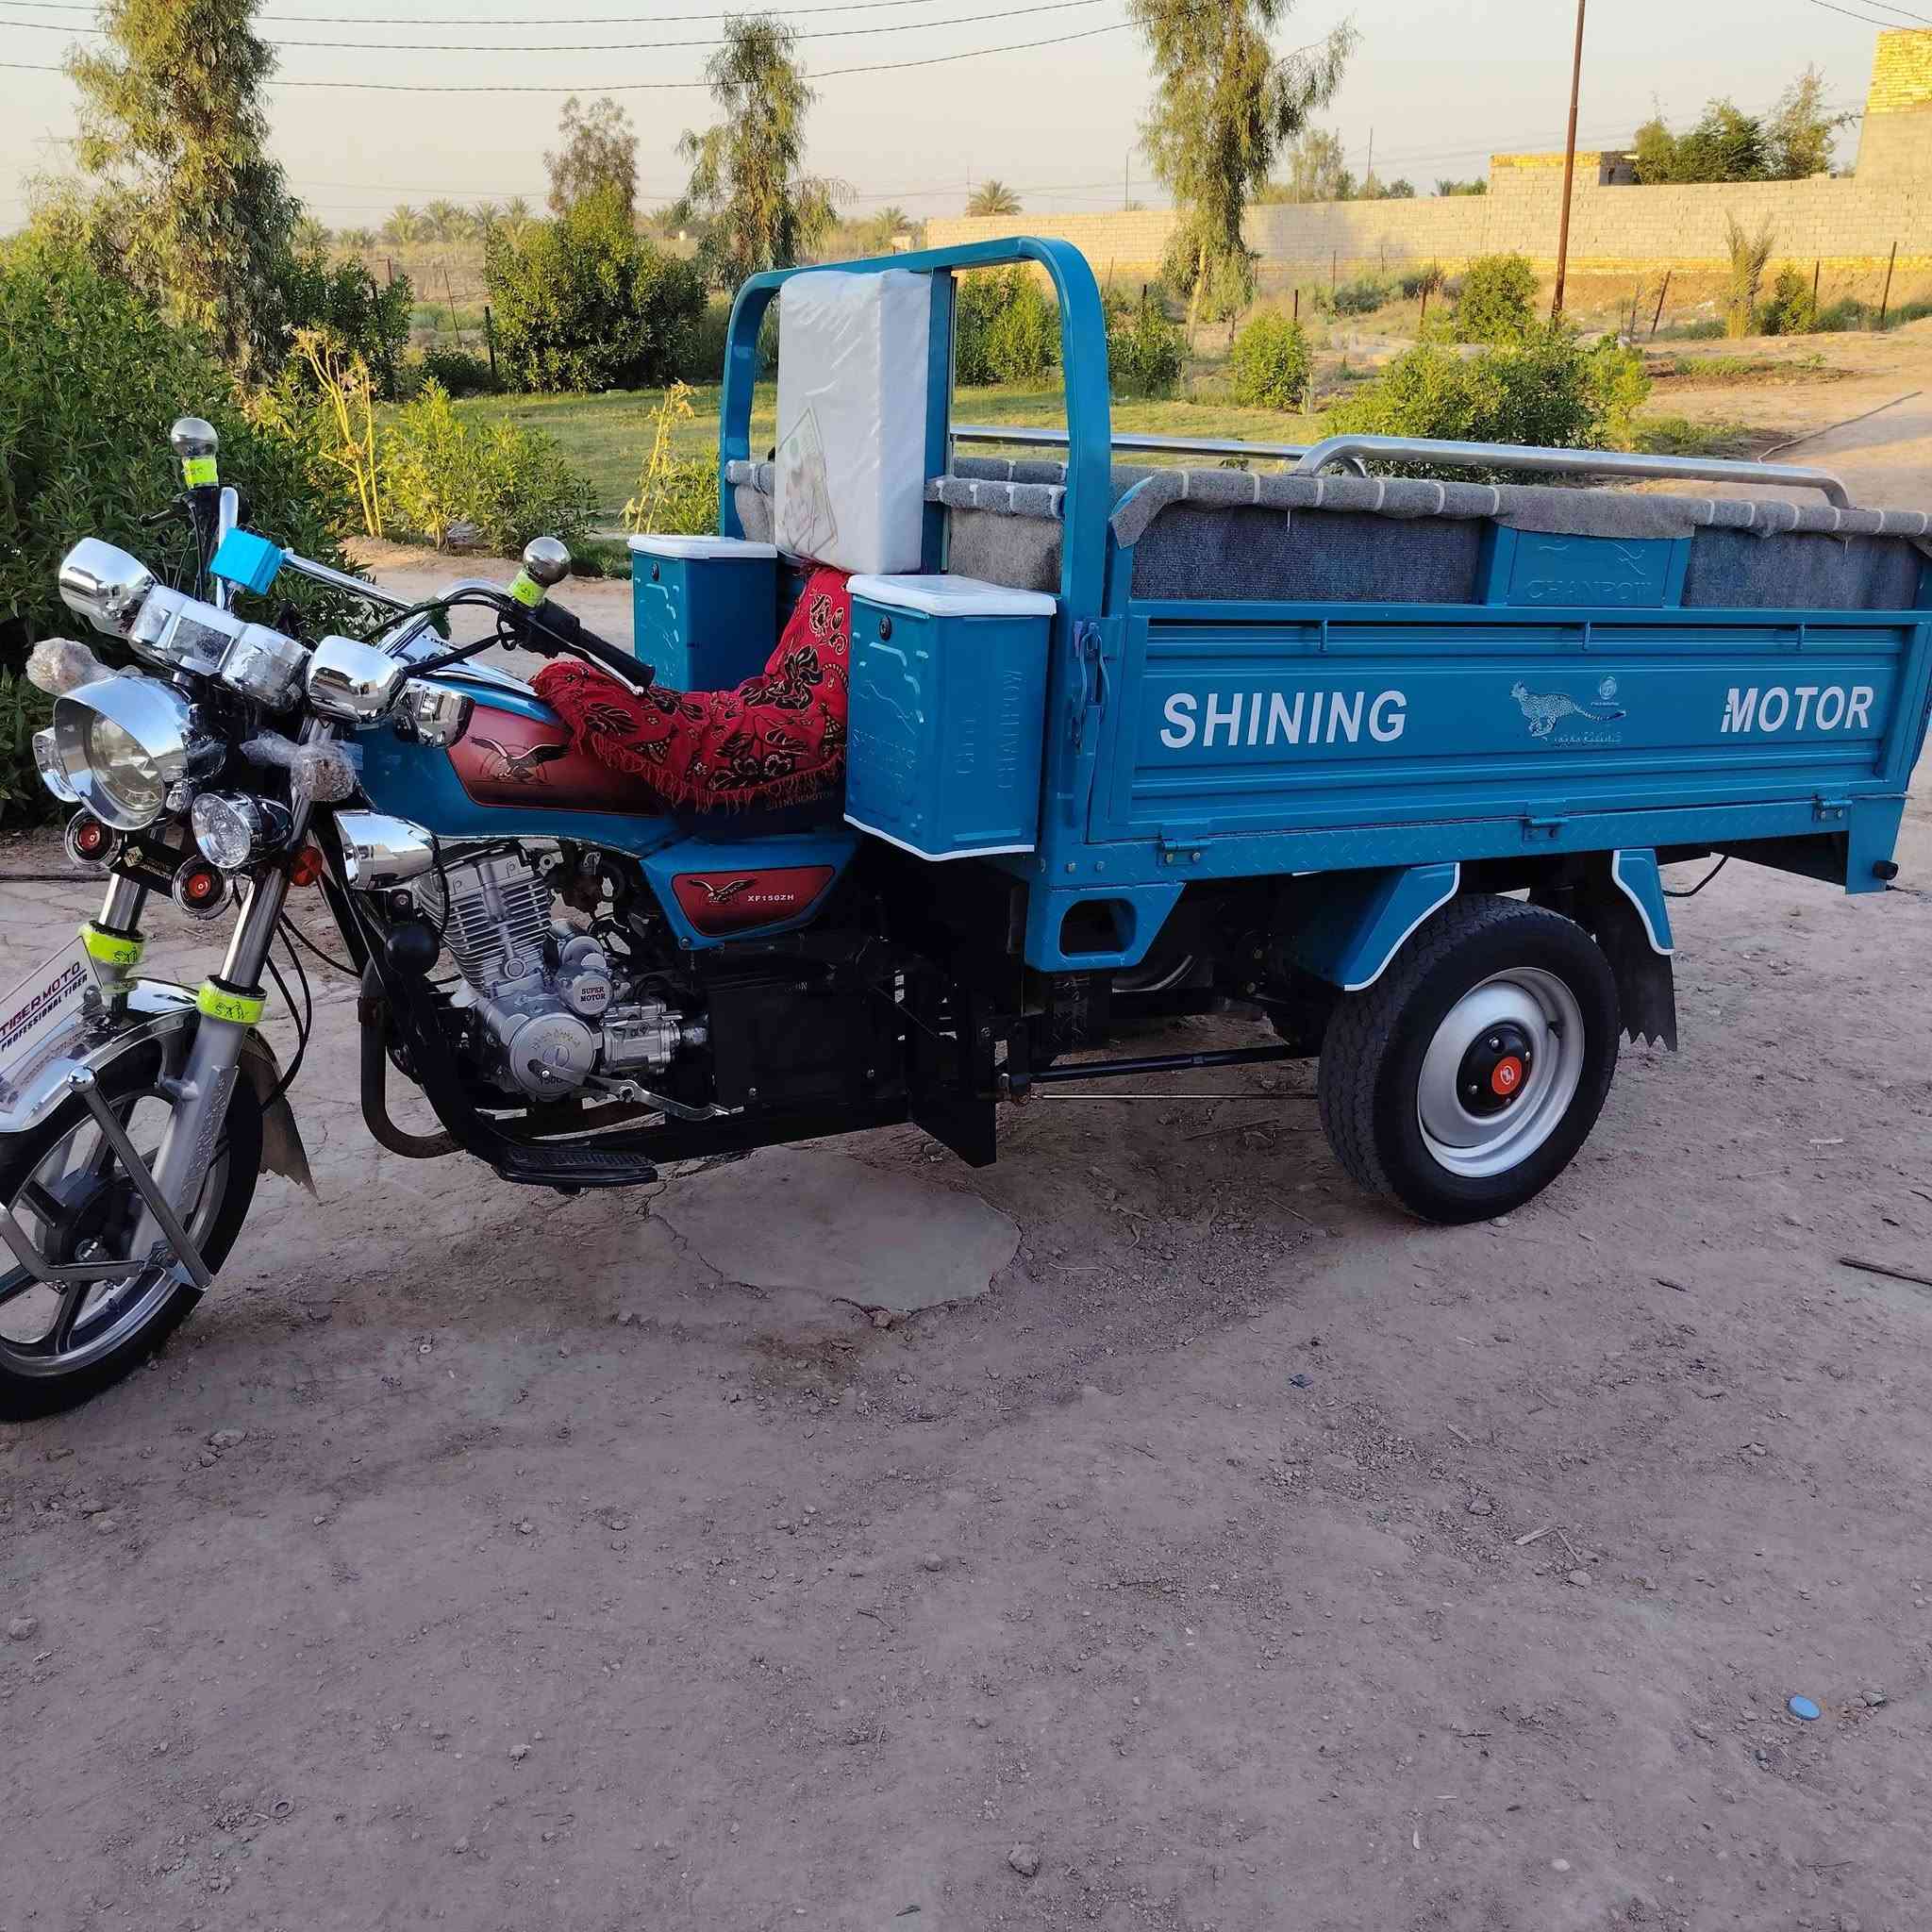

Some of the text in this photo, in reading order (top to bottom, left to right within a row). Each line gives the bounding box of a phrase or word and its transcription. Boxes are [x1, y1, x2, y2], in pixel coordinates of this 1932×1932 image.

[1160, 686, 1874, 748] SHINING MOTOR
[747, 894, 794, 903] XF150ZH
[581, 986, 605, 995] SUPER
[580, 993, 606, 1002] MOTOR
[1, 995, 61, 1053] PROFESSIONAL
